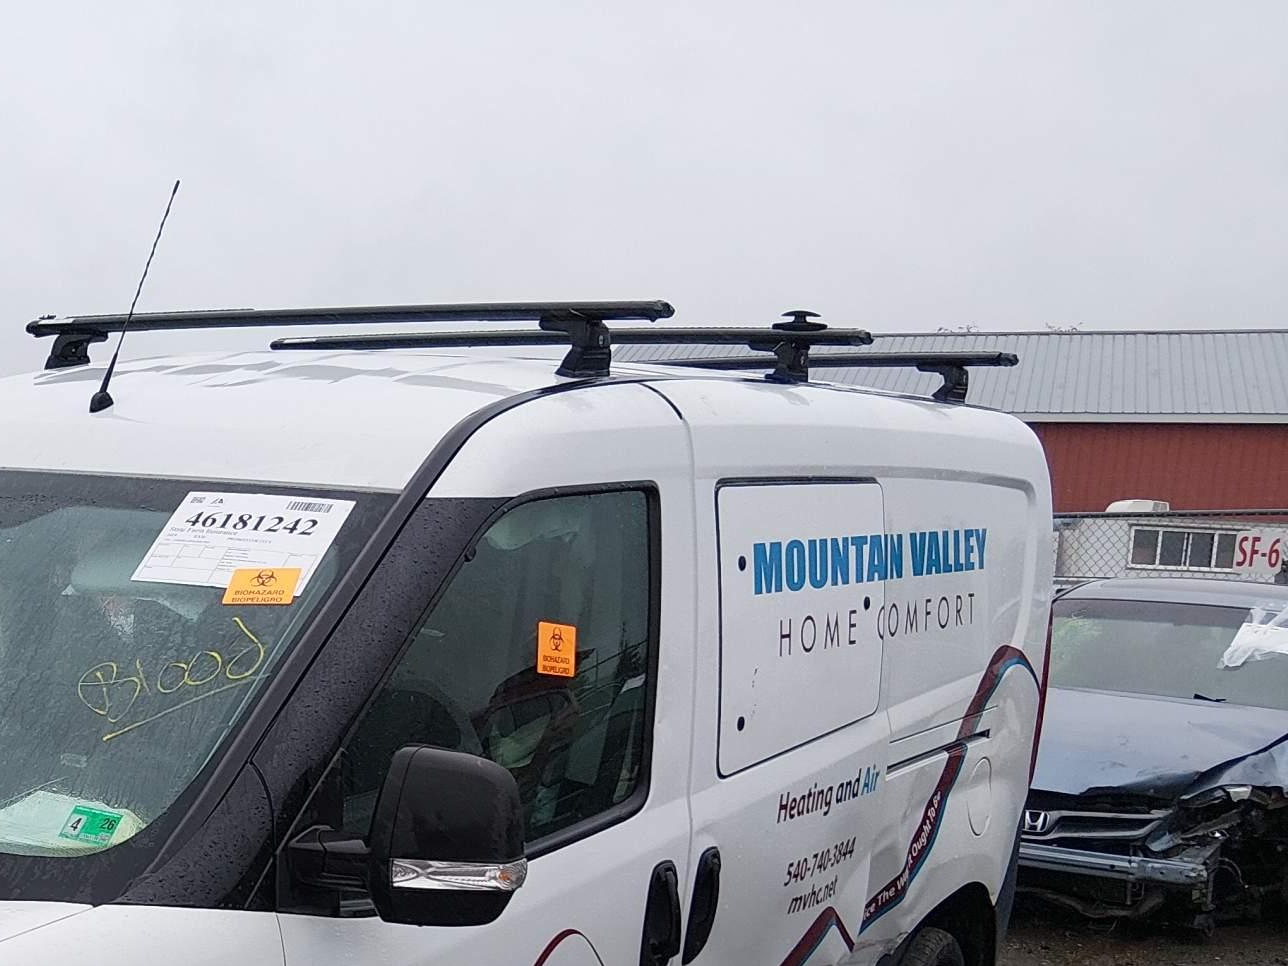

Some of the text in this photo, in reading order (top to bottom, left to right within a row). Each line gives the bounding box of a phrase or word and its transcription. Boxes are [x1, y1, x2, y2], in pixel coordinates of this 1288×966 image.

[186, 511, 319, 537] 46181242
[909, 527, 988, 578] VALLEY
[1235, 535, 1282, 569] SF-6
[778, 592, 976, 657] HOME COMFORT
[776, 763, 881, 825] Heating and Air
[70, 817, 83, 832] 4
[99, 817, 117, 831] 26
[783, 835, 857, 888] 540-740-3844
[877, 886, 897, 907] The
[911, 821, 933, 857] Ought
[786, 874, 839, 916] mvhc.net
